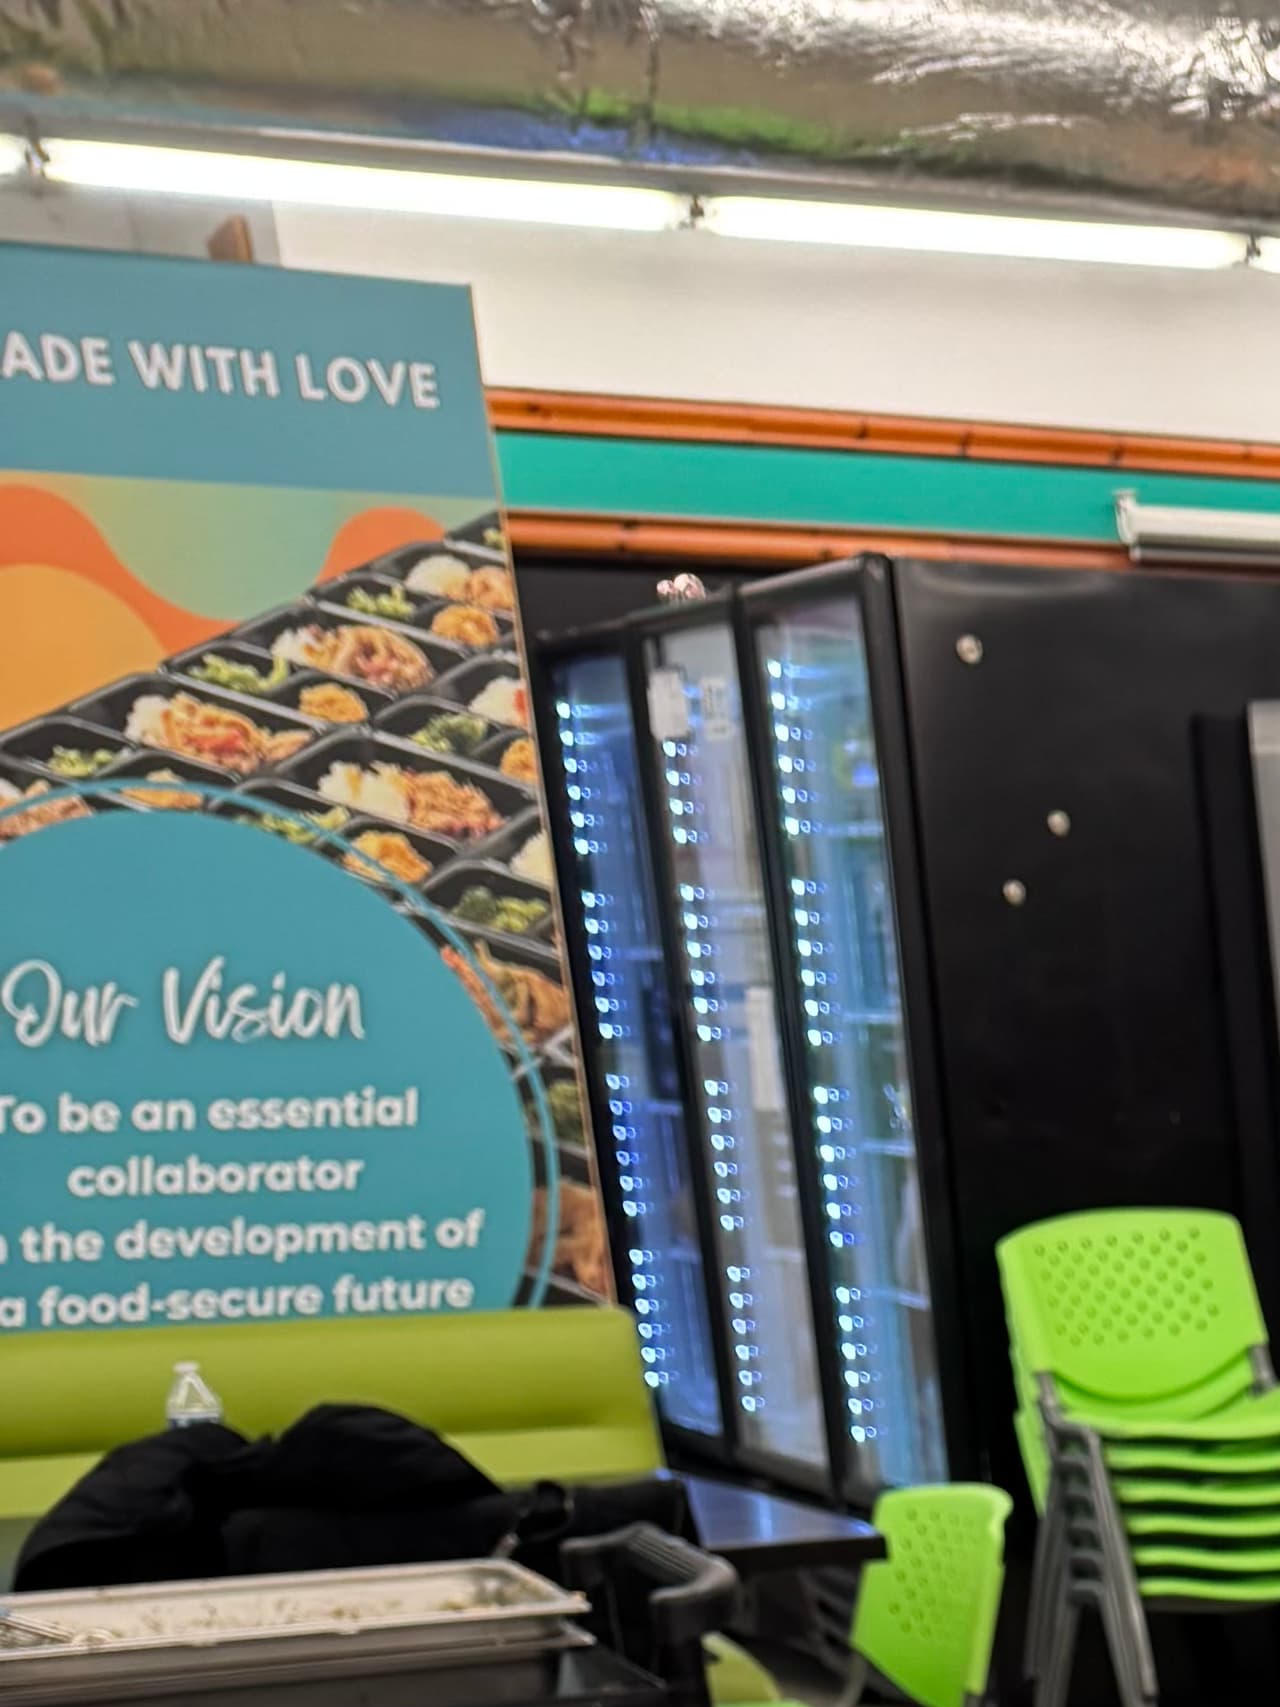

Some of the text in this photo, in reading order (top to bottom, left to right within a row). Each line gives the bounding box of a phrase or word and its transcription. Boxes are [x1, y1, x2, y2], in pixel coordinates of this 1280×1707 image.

[128, 340, 281, 397] WITH
[295, 353, 441, 409] LOVE
[2, 955, 366, 1047] Our Vision
[58, 1092, 120, 1133] be
[131, 1099, 196, 1131] an
[207, 1086, 419, 1129] essential
[67, 1154, 365, 1198] collaborator
[20, 1222, 104, 1263] the
[115, 1215, 426, 1262] development
[435, 1208, 485, 1247] of
[0, 1274, 474, 1328] a food-secure future
